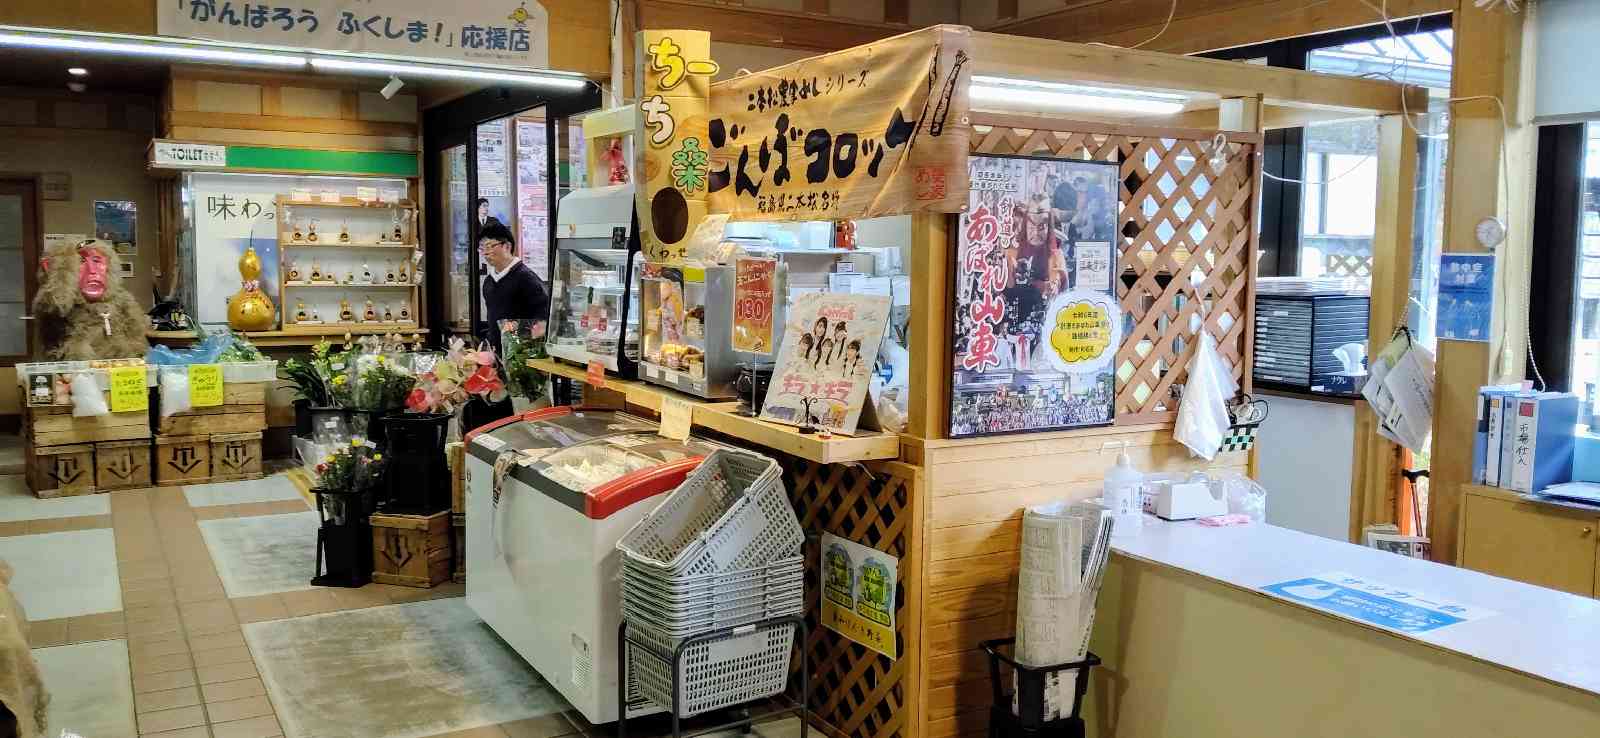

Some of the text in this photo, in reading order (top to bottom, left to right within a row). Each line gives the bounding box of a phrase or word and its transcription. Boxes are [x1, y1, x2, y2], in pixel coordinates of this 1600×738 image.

[171, 148, 203, 161] TOILET
[963, 205, 1010, 373] あばれ山車
